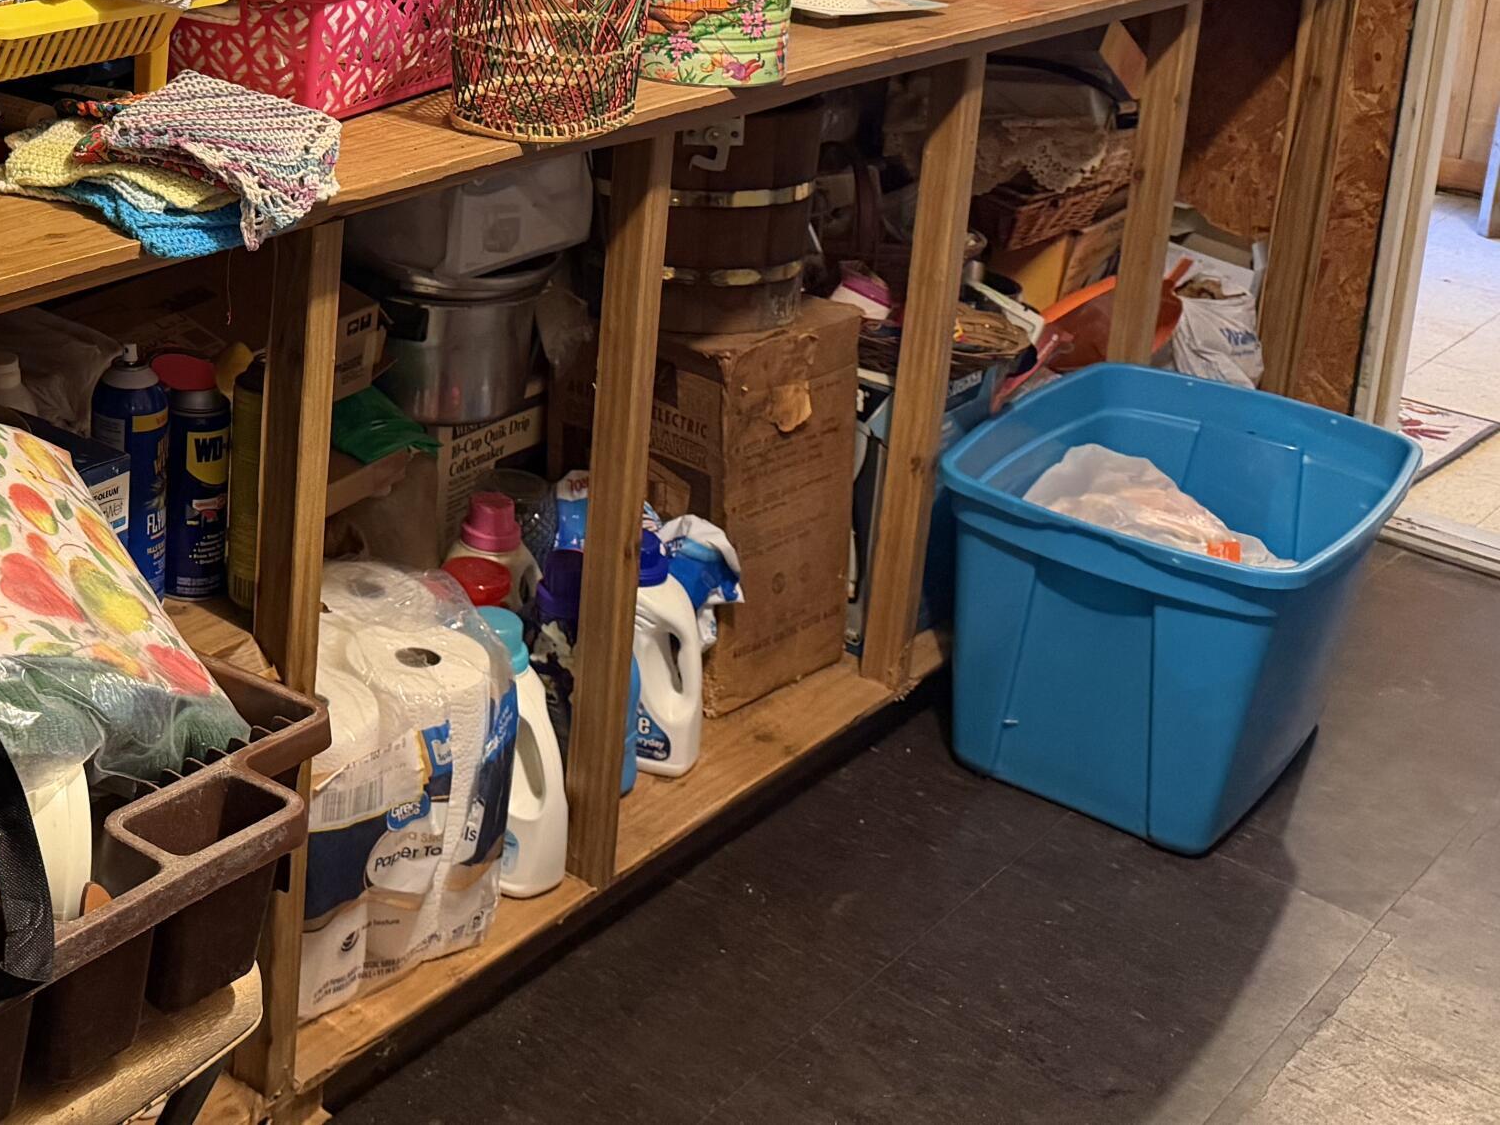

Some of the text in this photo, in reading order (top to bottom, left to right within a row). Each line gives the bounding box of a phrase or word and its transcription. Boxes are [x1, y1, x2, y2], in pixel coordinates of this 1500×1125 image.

[509, 416, 531, 435] Drip
[652, 407, 708, 439] ELECTRIC
[194, 435, 229, 463] WD-
[375, 845, 417, 872] Paper
